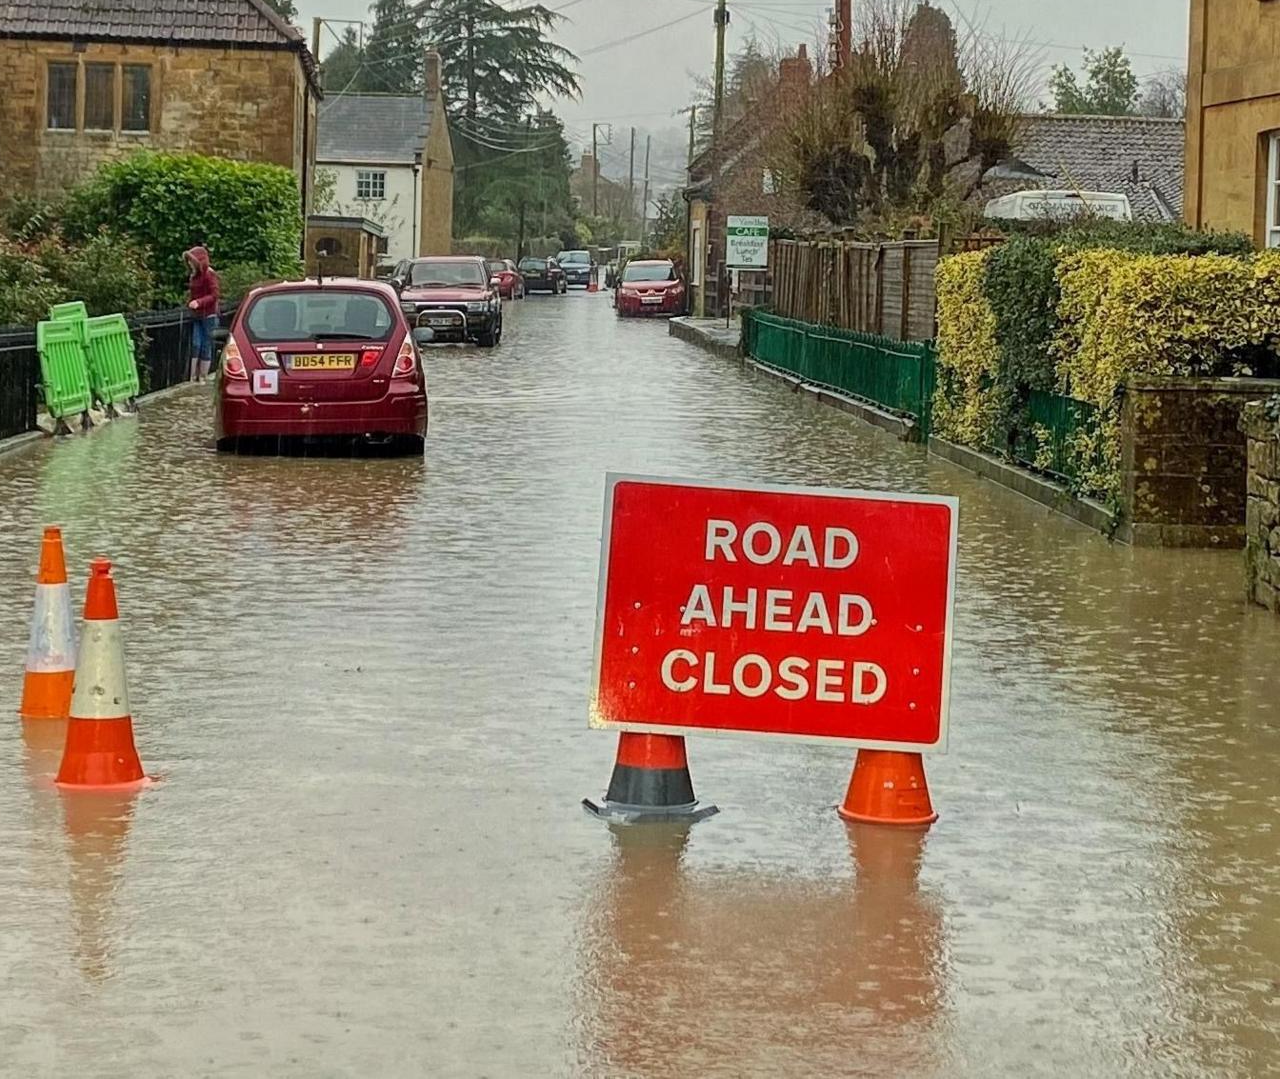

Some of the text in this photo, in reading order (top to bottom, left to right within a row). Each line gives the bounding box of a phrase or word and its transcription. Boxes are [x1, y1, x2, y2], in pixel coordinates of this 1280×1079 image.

[731, 239, 763, 247] Breakfast
[736, 247, 758, 255] Lunch
[294, 355, 352, 367] BD54 FFR
[259, 375, 272, 388] L
[705, 519, 859, 569] ROAD
[680, 584, 872, 636] AHEAD
[660, 648, 887, 704] CLOSED
